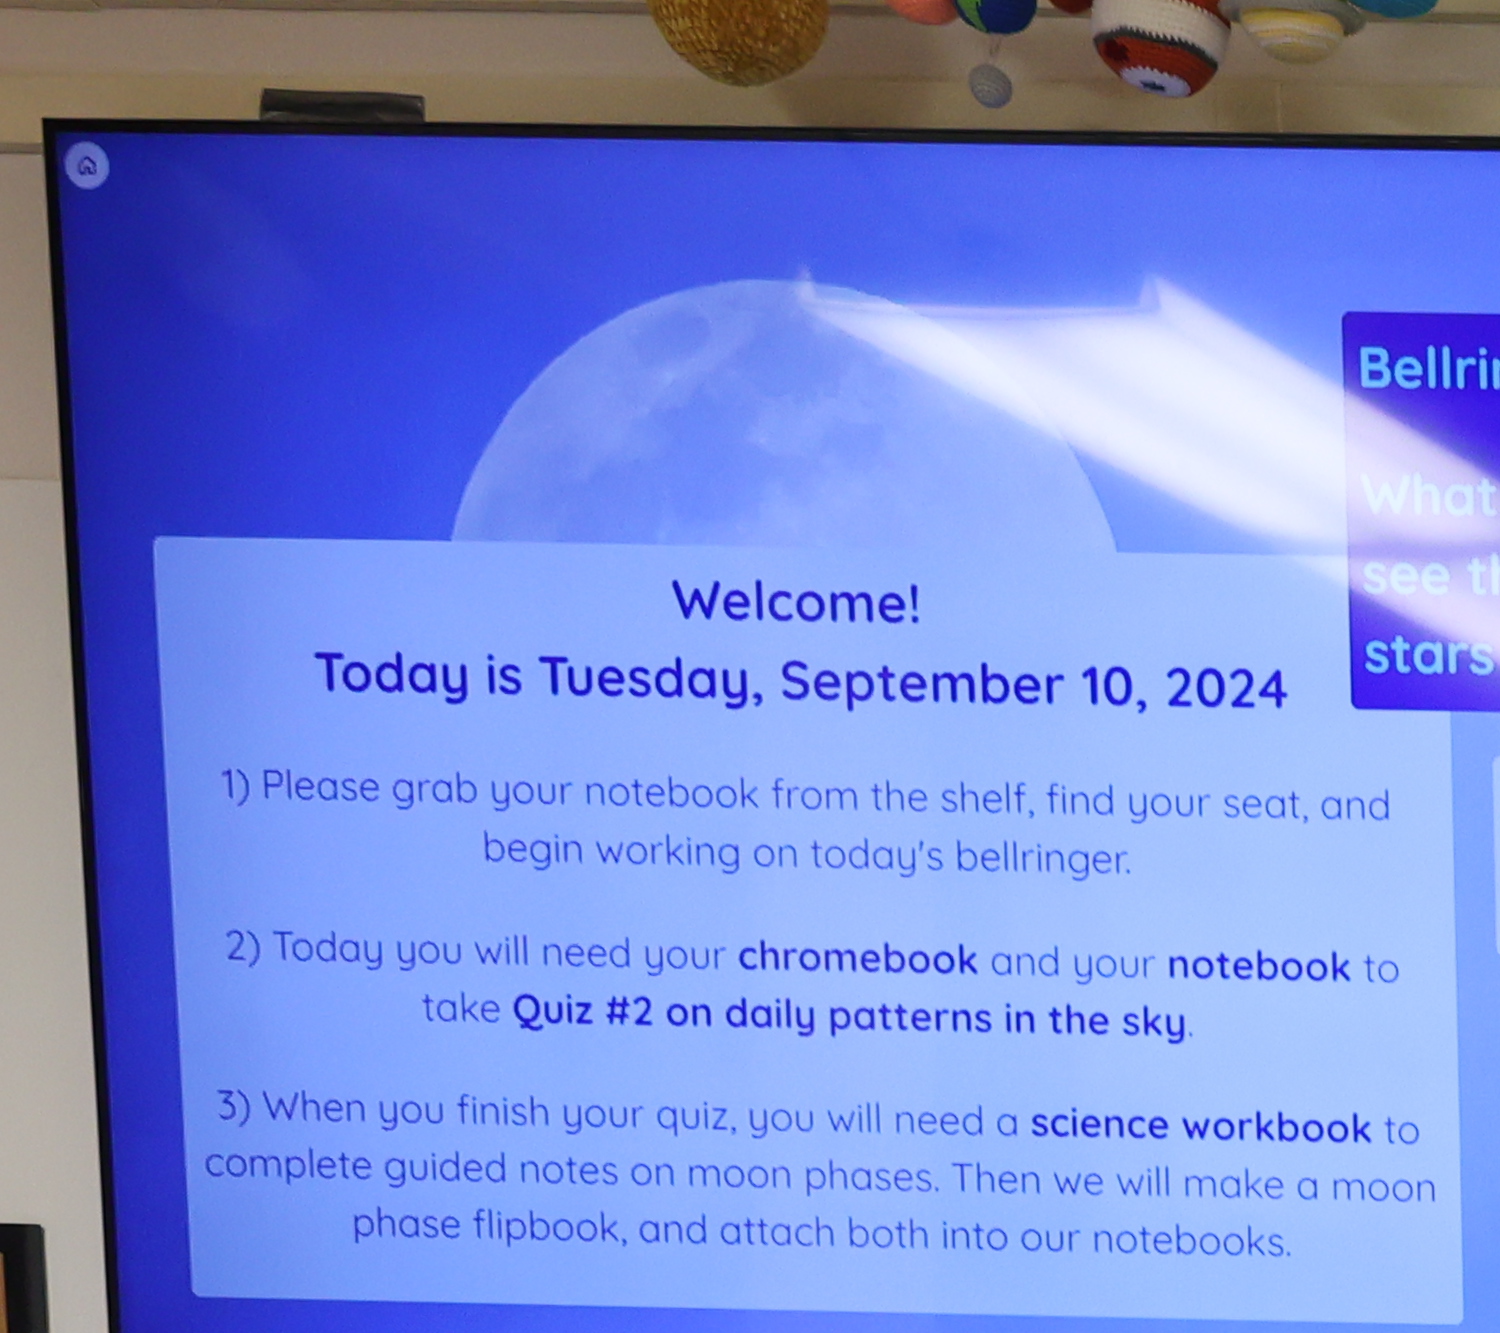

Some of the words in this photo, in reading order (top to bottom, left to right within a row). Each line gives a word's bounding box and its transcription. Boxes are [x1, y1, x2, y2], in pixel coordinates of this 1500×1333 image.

[1360, 471, 1497, 515] What
[672, 579, 919, 624] Welcome!
[1362, 559, 1450, 596] see
[1364, 634, 1496, 676] stars
[315, 651, 468, 704] Today
[487, 654, 521, 695] is
[539, 656, 763, 709] Tuesday,
[782, 660, 1064, 712] September
[1082, 666, 1146, 714] 10,
[1167, 667, 1288, 709] 2024
[222, 768, 249, 807] 1)
[263, 769, 379, 802] Please
[393, 771, 477, 810] grab
[491, 781, 573, 812] your
[586, 775, 758, 808] notebook
[772, 778, 858, 811] from
[871, 780, 928, 812] the
[942, 781, 1034, 818] shelf,
[1046, 782, 1113, 815] find
[1129, 793, 1210, 824] your
[1224, 791, 1308, 823] seat,
[1321, 789, 1389, 821] and
[484, 830, 582, 871] begin
[596, 834, 739, 875] working
[754, 844, 797, 868] on
[811, 838, 943, 878] today's
[957, 839, 1130, 882] bellringer.
[227, 929, 260, 967] 2)
[273, 931, 382, 971] Today
[397, 941, 461, 971] you
[475, 935, 528, 965] will
[543, 937, 630, 968] need
[645, 946, 725, 976] your
[739, 939, 978, 975] chromebook
[992, 946, 1059, 976] and
[1075, 955, 1155, 985] your
[1169, 949, 1351, 982] notebook
[1364, 955, 1399, 983] to
[423, 992, 500, 1023] take
[514, 993, 593, 1031] Quiz
[606, 996, 652, 1025] #2
[667, 1004, 711, 1027] on
[726, 997, 814, 1037] daily
[830, 1003, 992, 1037] patterns
[1006, 1004, 1035, 1033] in
[1049, 1004, 1109, 1035] the
[1123, 1005, 1193, 1045] sky.
[217, 1089, 250, 1127] 3)
[263, 1090, 365, 1122] When
[379, 1101, 443, 1131] you
[457, 1094, 549, 1126] finish
[564, 1104, 643, 1135] your
[657, 1106, 736, 1136] quiz,
[750, 1109, 813, 1139] you
[828, 1102, 880, 1133] will
[896, 1105, 983, 1136] need
[997, 1113, 1017, 1136] a
[1032, 1108, 1169, 1139] science
[1182, 1111, 1372, 1144] workbook
[1385, 1117, 1419, 1145] to
[205, 1146, 372, 1186] complete
[385, 1150, 506, 1188] guided
[521, 1157, 618, 1185] notes
[631, 1163, 674, 1186] on
[689, 1165, 791, 1189] moon
[806, 1159, 939, 1196] phases.
[952, 1162, 1040, 1194] Then
[1054, 1172, 1103, 1196] we
[1117, 1165, 1169, 1196] will
[1185, 1168, 1284, 1200] make
[1297, 1177, 1317, 1200] a
[1333, 1178, 1435, 1202] moon
[354, 1206, 460, 1243] phase
[473, 1208, 627, 1248] flipbook,
[639, 1213, 707, 1244] and
[720, 1216, 834, 1247] attach
[849, 1216, 928, 1249] both
[943, 1221, 1008, 1251] into
[1021, 1229, 1080, 1252] our
[1094, 1223, 1291, 1257] notebooks.
